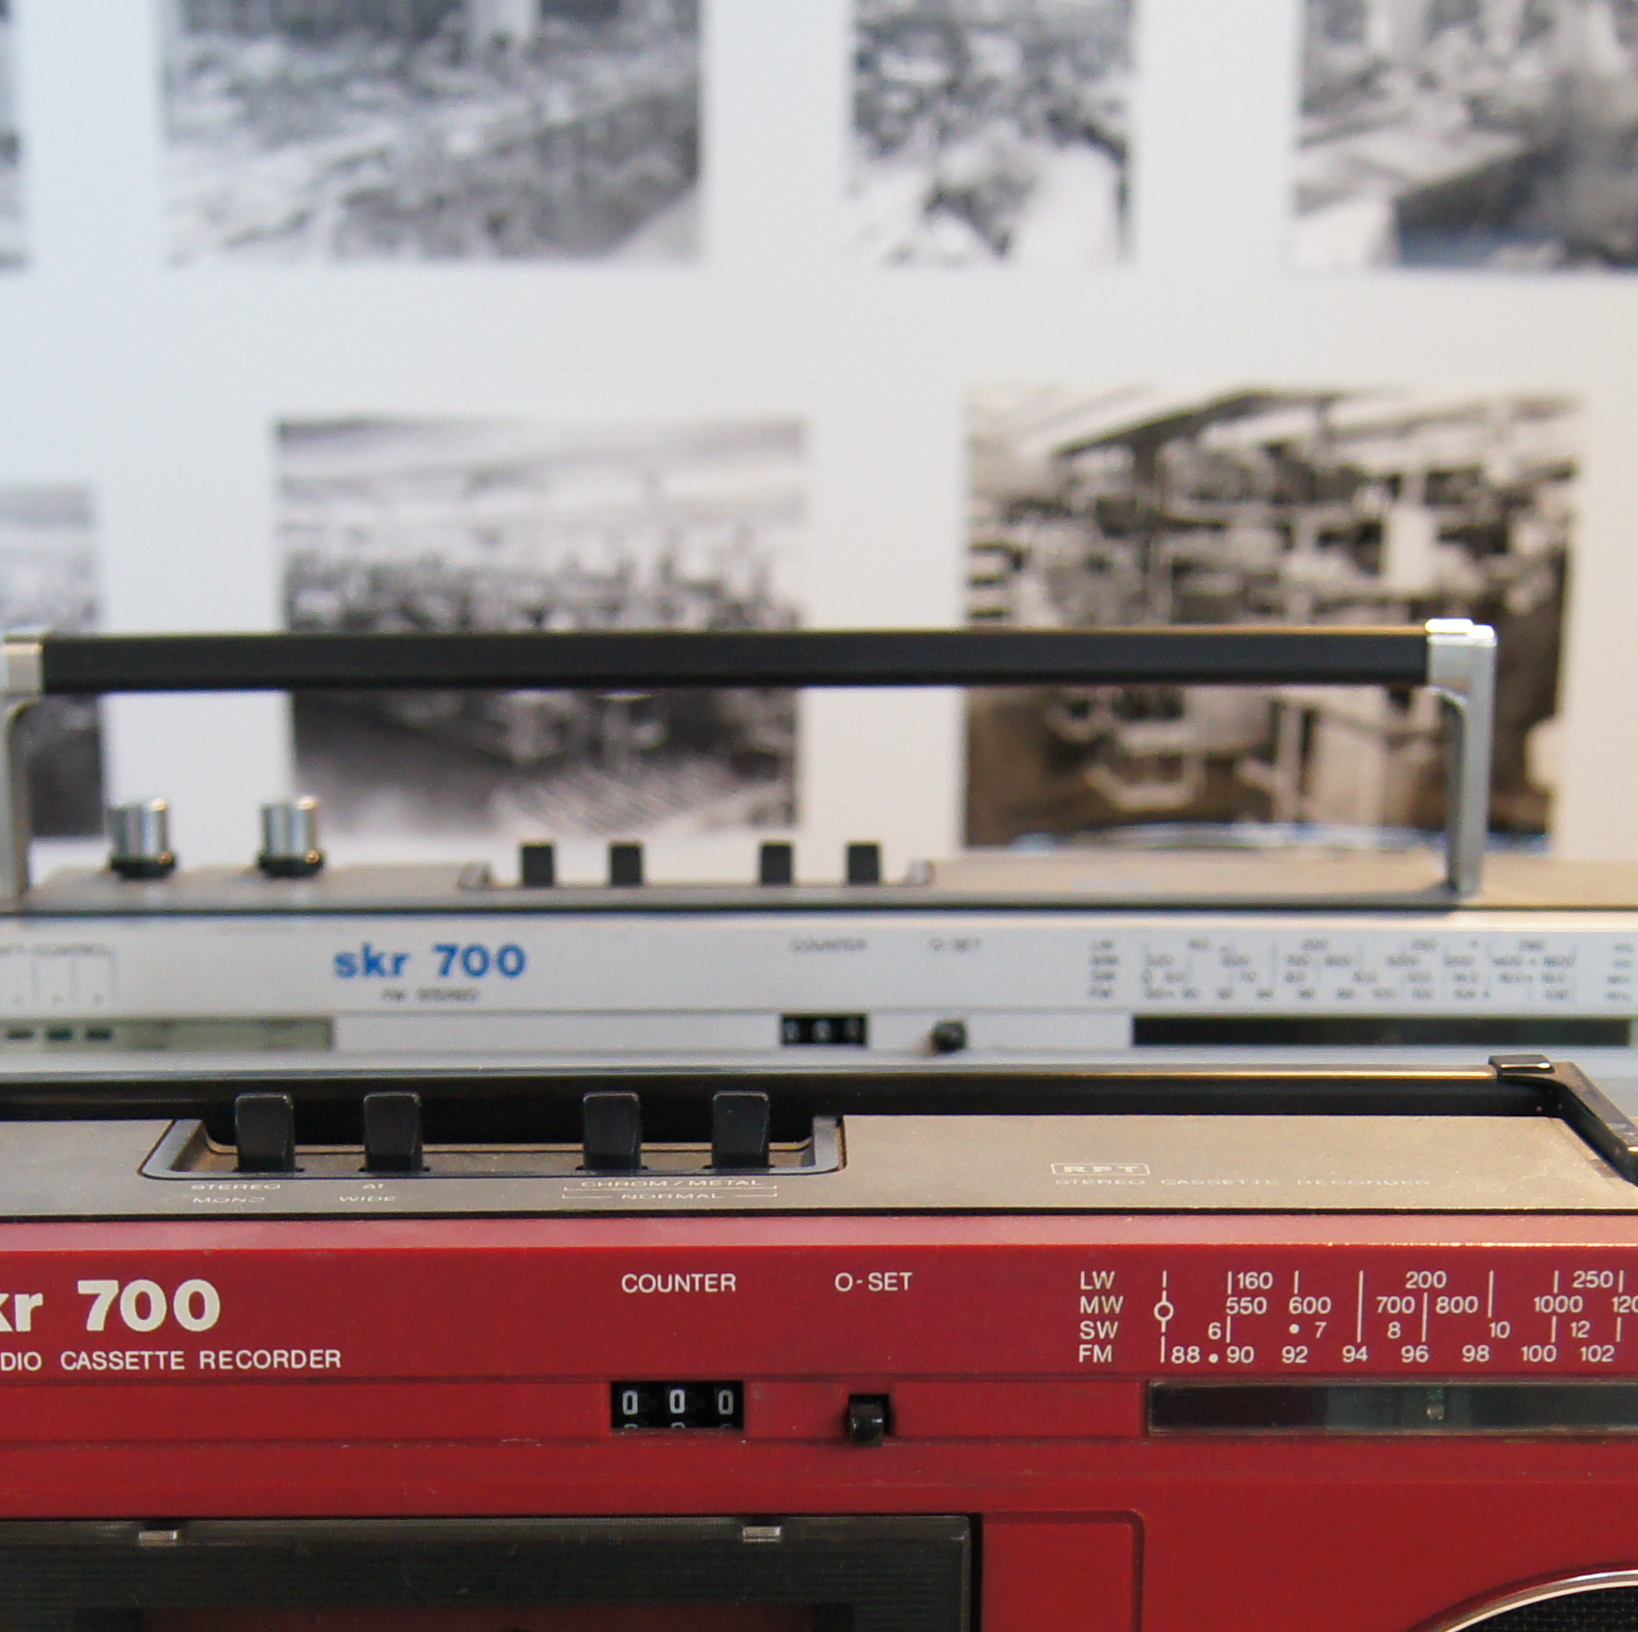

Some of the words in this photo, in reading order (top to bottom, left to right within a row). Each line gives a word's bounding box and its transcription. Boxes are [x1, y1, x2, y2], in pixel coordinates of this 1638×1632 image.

[333, 942, 411, 977] skr
[433, 943, 526, 978] 700
[621, 1272, 737, 1294] COUNTER
[1080, 1270, 1116, 1291] LW
[1236, 1271, 1274, 1290] 160
[1405, 1270, 1448, 1289] 200
[1572, 1270, 1614, 1289] 250
[77, 1278, 221, 1333] 700
[1079, 1295, 1124, 1315] MW
[1225, 1296, 1268, 1315] 550
[1288, 1296, 1332, 1315] 600
[1376, 1295, 1416, 1315] 700
[1435, 1295, 1479, 1315] 800
[1533, 1294, 1584, 1314] 1000
[1079, 1320, 1119, 1340] SW
[1207, 1321, 1222, 1340] 6
[1314, 1321, 1328, 1339] 7
[1386, 1320, 1402, 1340] 8
[1489, 1320, 1511, 1339] 10
[1570, 1320, 1591, 1339] 12
[60, 1350, 186, 1371] CASSETTE
[199, 1349, 342, 1370] RECORDER
[1078, 1343, 1113, 1363] FM
[1170, 1345, 1201, 1365] 88
[1226, 1345, 1255, 1364] 90
[1281, 1345, 1309, 1364] 92
[1342, 1345, 1369, 1363] 94
[1400, 1344, 1430, 1364] 96
[1461, 1344, 1490, 1363] 98
[1521, 1344, 1558, 1363] 100
[1580, 1344, 1615, 1363] 102
